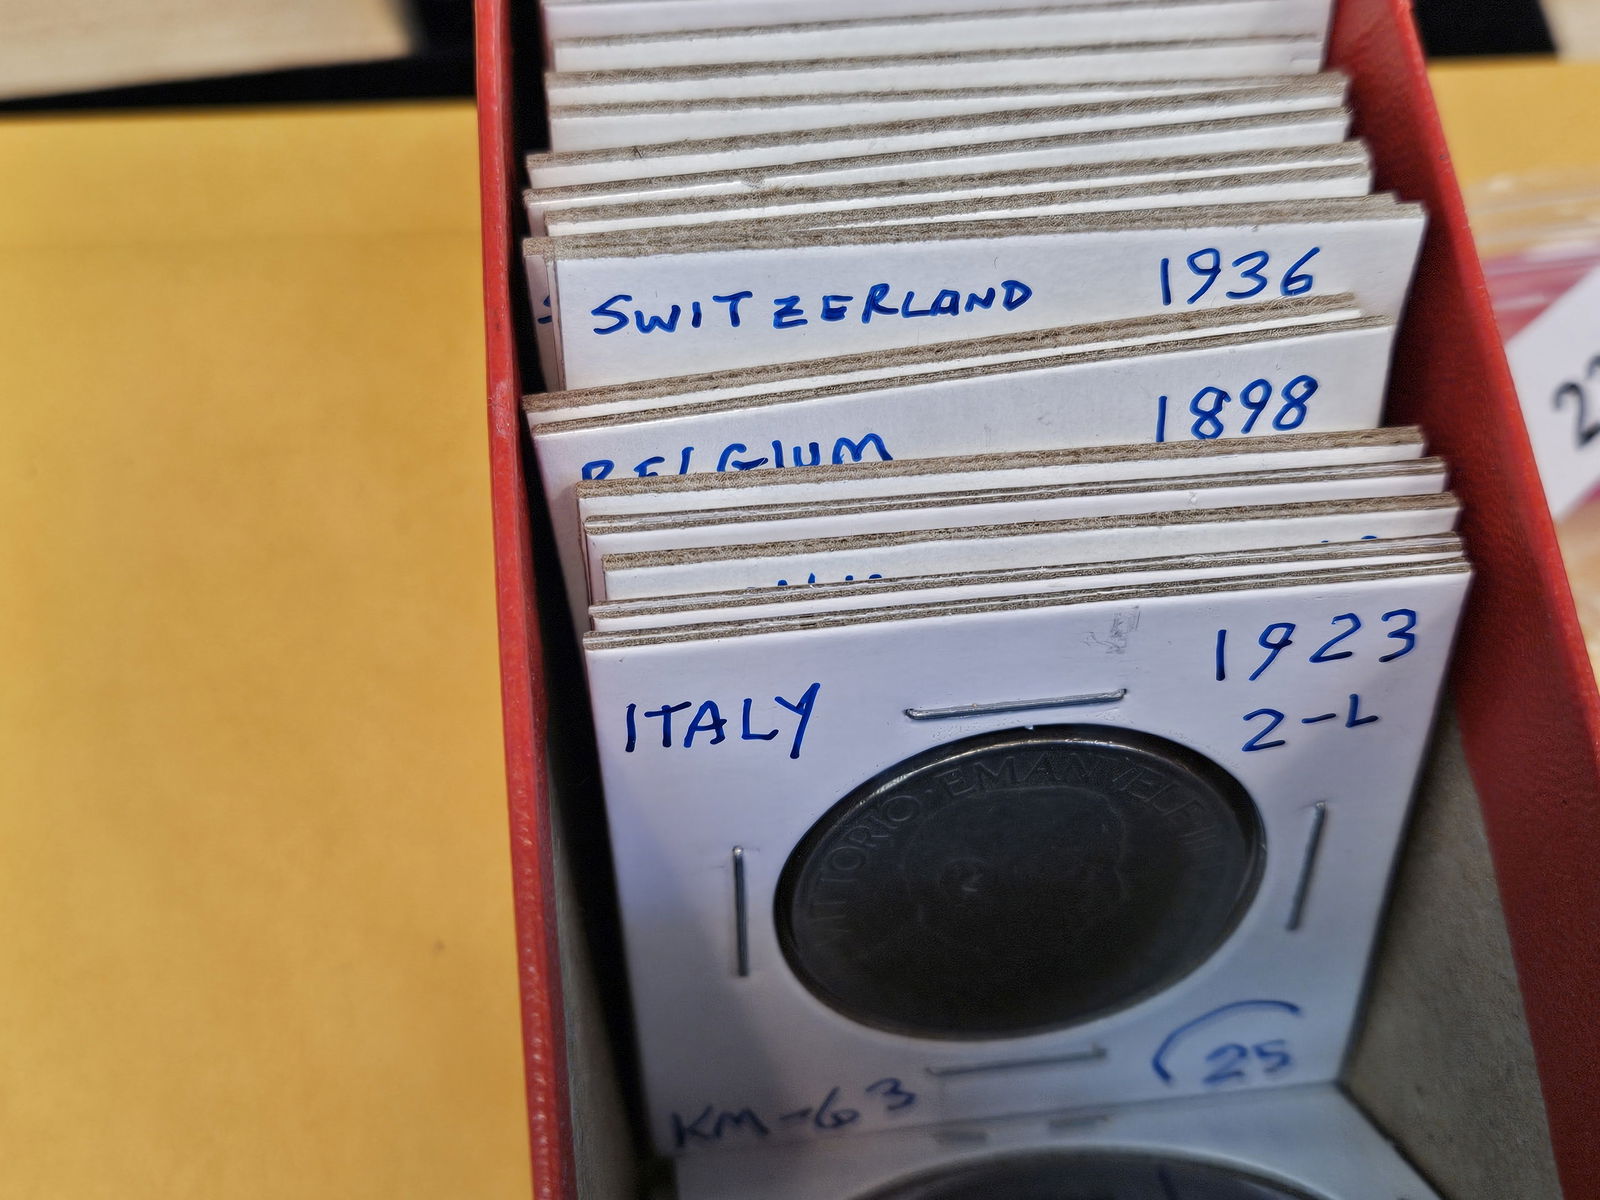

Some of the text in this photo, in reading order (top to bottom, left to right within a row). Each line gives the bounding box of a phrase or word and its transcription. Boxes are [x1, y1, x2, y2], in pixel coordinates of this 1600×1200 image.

[591, 281, 1034, 336] SWITZERLAND
[1160, 247, 1321, 305] 1936
[1156, 375, 1319, 442] 1898
[1214, 608, 1418, 682] 1923
[625, 682, 821, 759] ITALY
[1242, 694, 1380, 752] 2-L
[1202, 1038, 1292, 1086] 25
